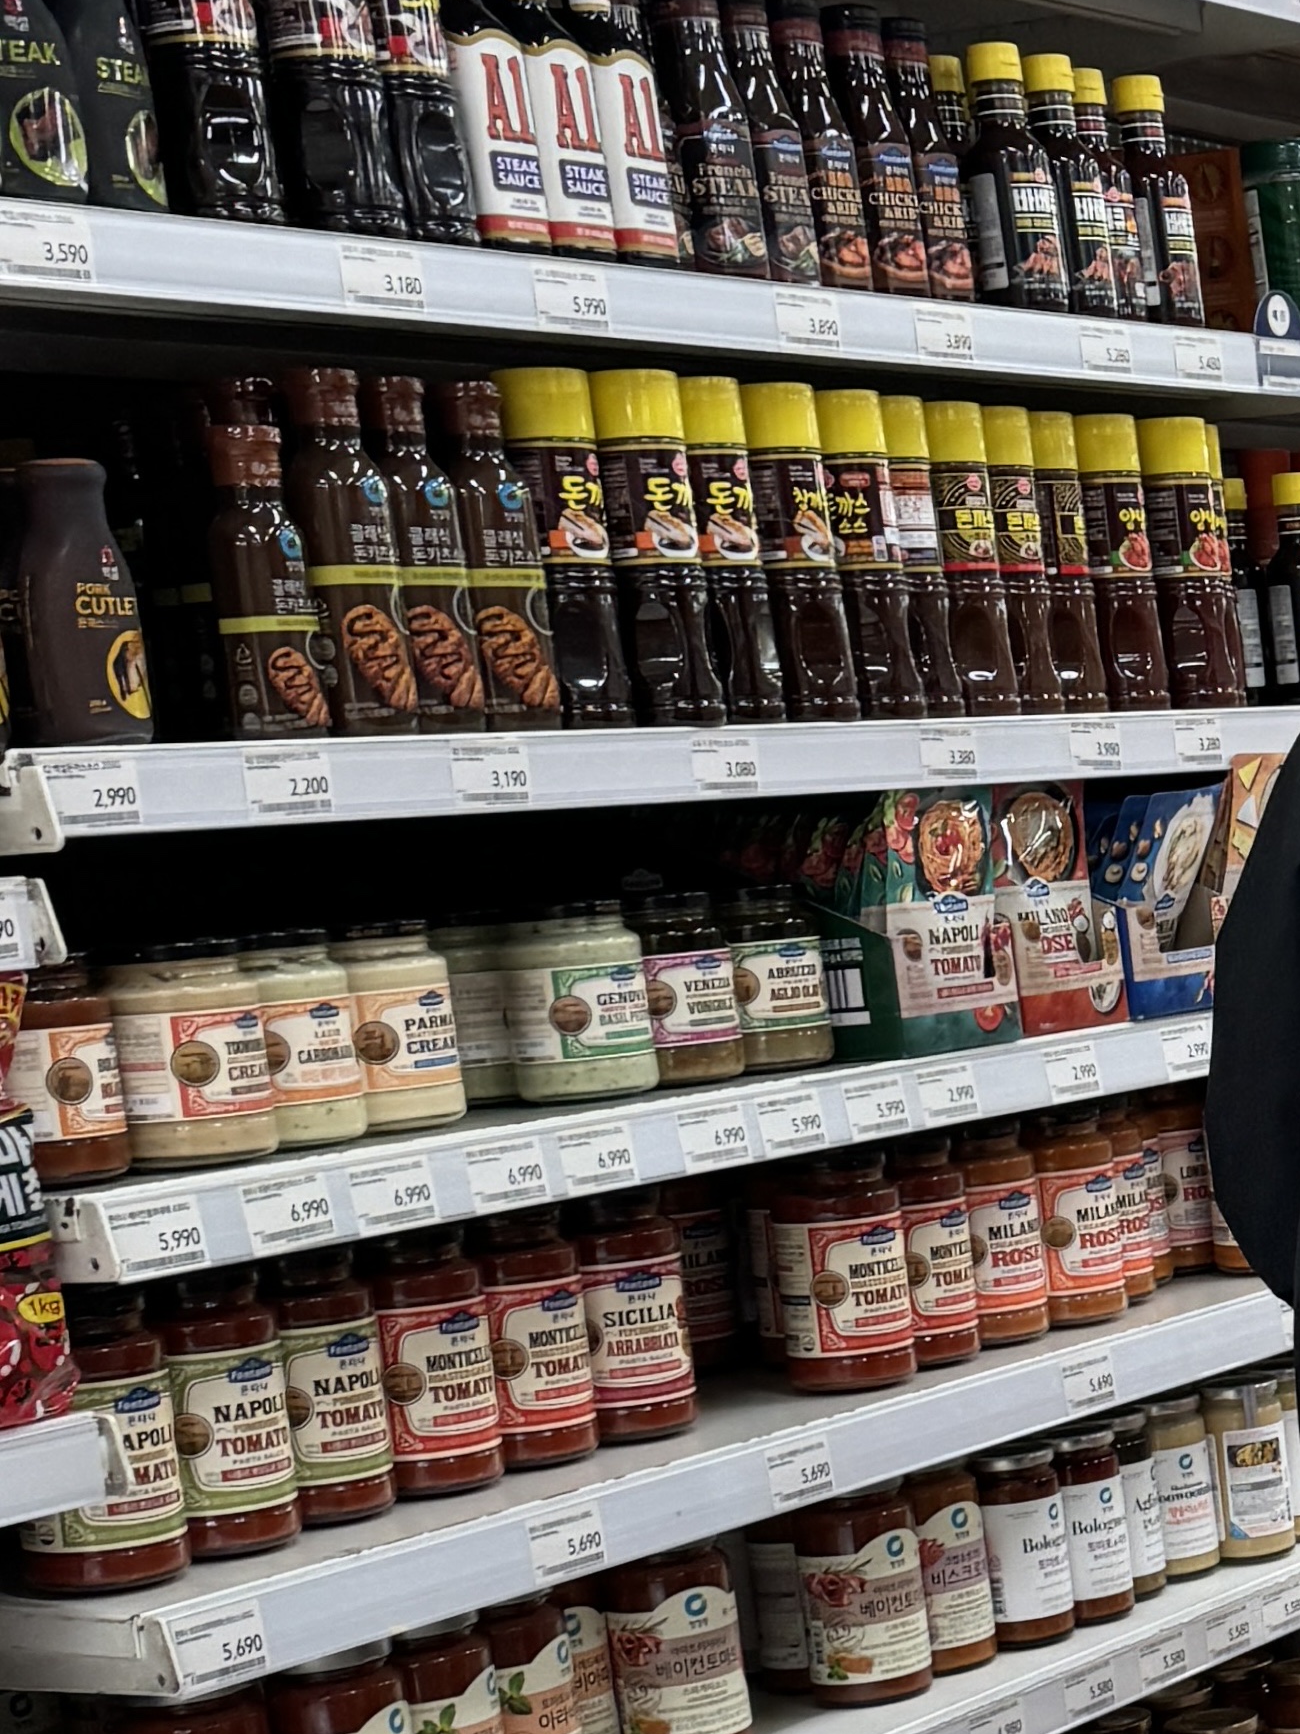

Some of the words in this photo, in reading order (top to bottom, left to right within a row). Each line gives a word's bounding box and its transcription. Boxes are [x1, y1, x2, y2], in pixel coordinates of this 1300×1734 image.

[497, 156, 539, 173] STEAK
[565, 165, 606, 182] STEAK
[499, 172, 541, 190] SAUCE
[566, 180, 608, 197] SAUCE
[42, 242, 88, 264] 3,590
[384, 275, 422, 294] 3,180
[573, 295, 606, 315] 5,990
[290, 777, 329, 795] 2,200
[492, 770, 527, 788] 3,190
[93, 787, 136, 808] 2,990
[791, 1114, 821, 1133] 5,990
[714, 1125, 746, 1145] 6,990
[597, 1148, 631, 1168] 6,990
[508, 1164, 543, 1185] 6,990
[393, 1184, 431, 1207] 6,990
[290, 1198, 330, 1222] 6,990
[159, 1227, 200, 1251] 5,990
[604, 1303, 675, 1327] SICILIA
[800, 1463, 831, 1486] 5,690
[566, 1530, 601, 1555] 5,690
[221, 1635, 264, 1661] 5,690
